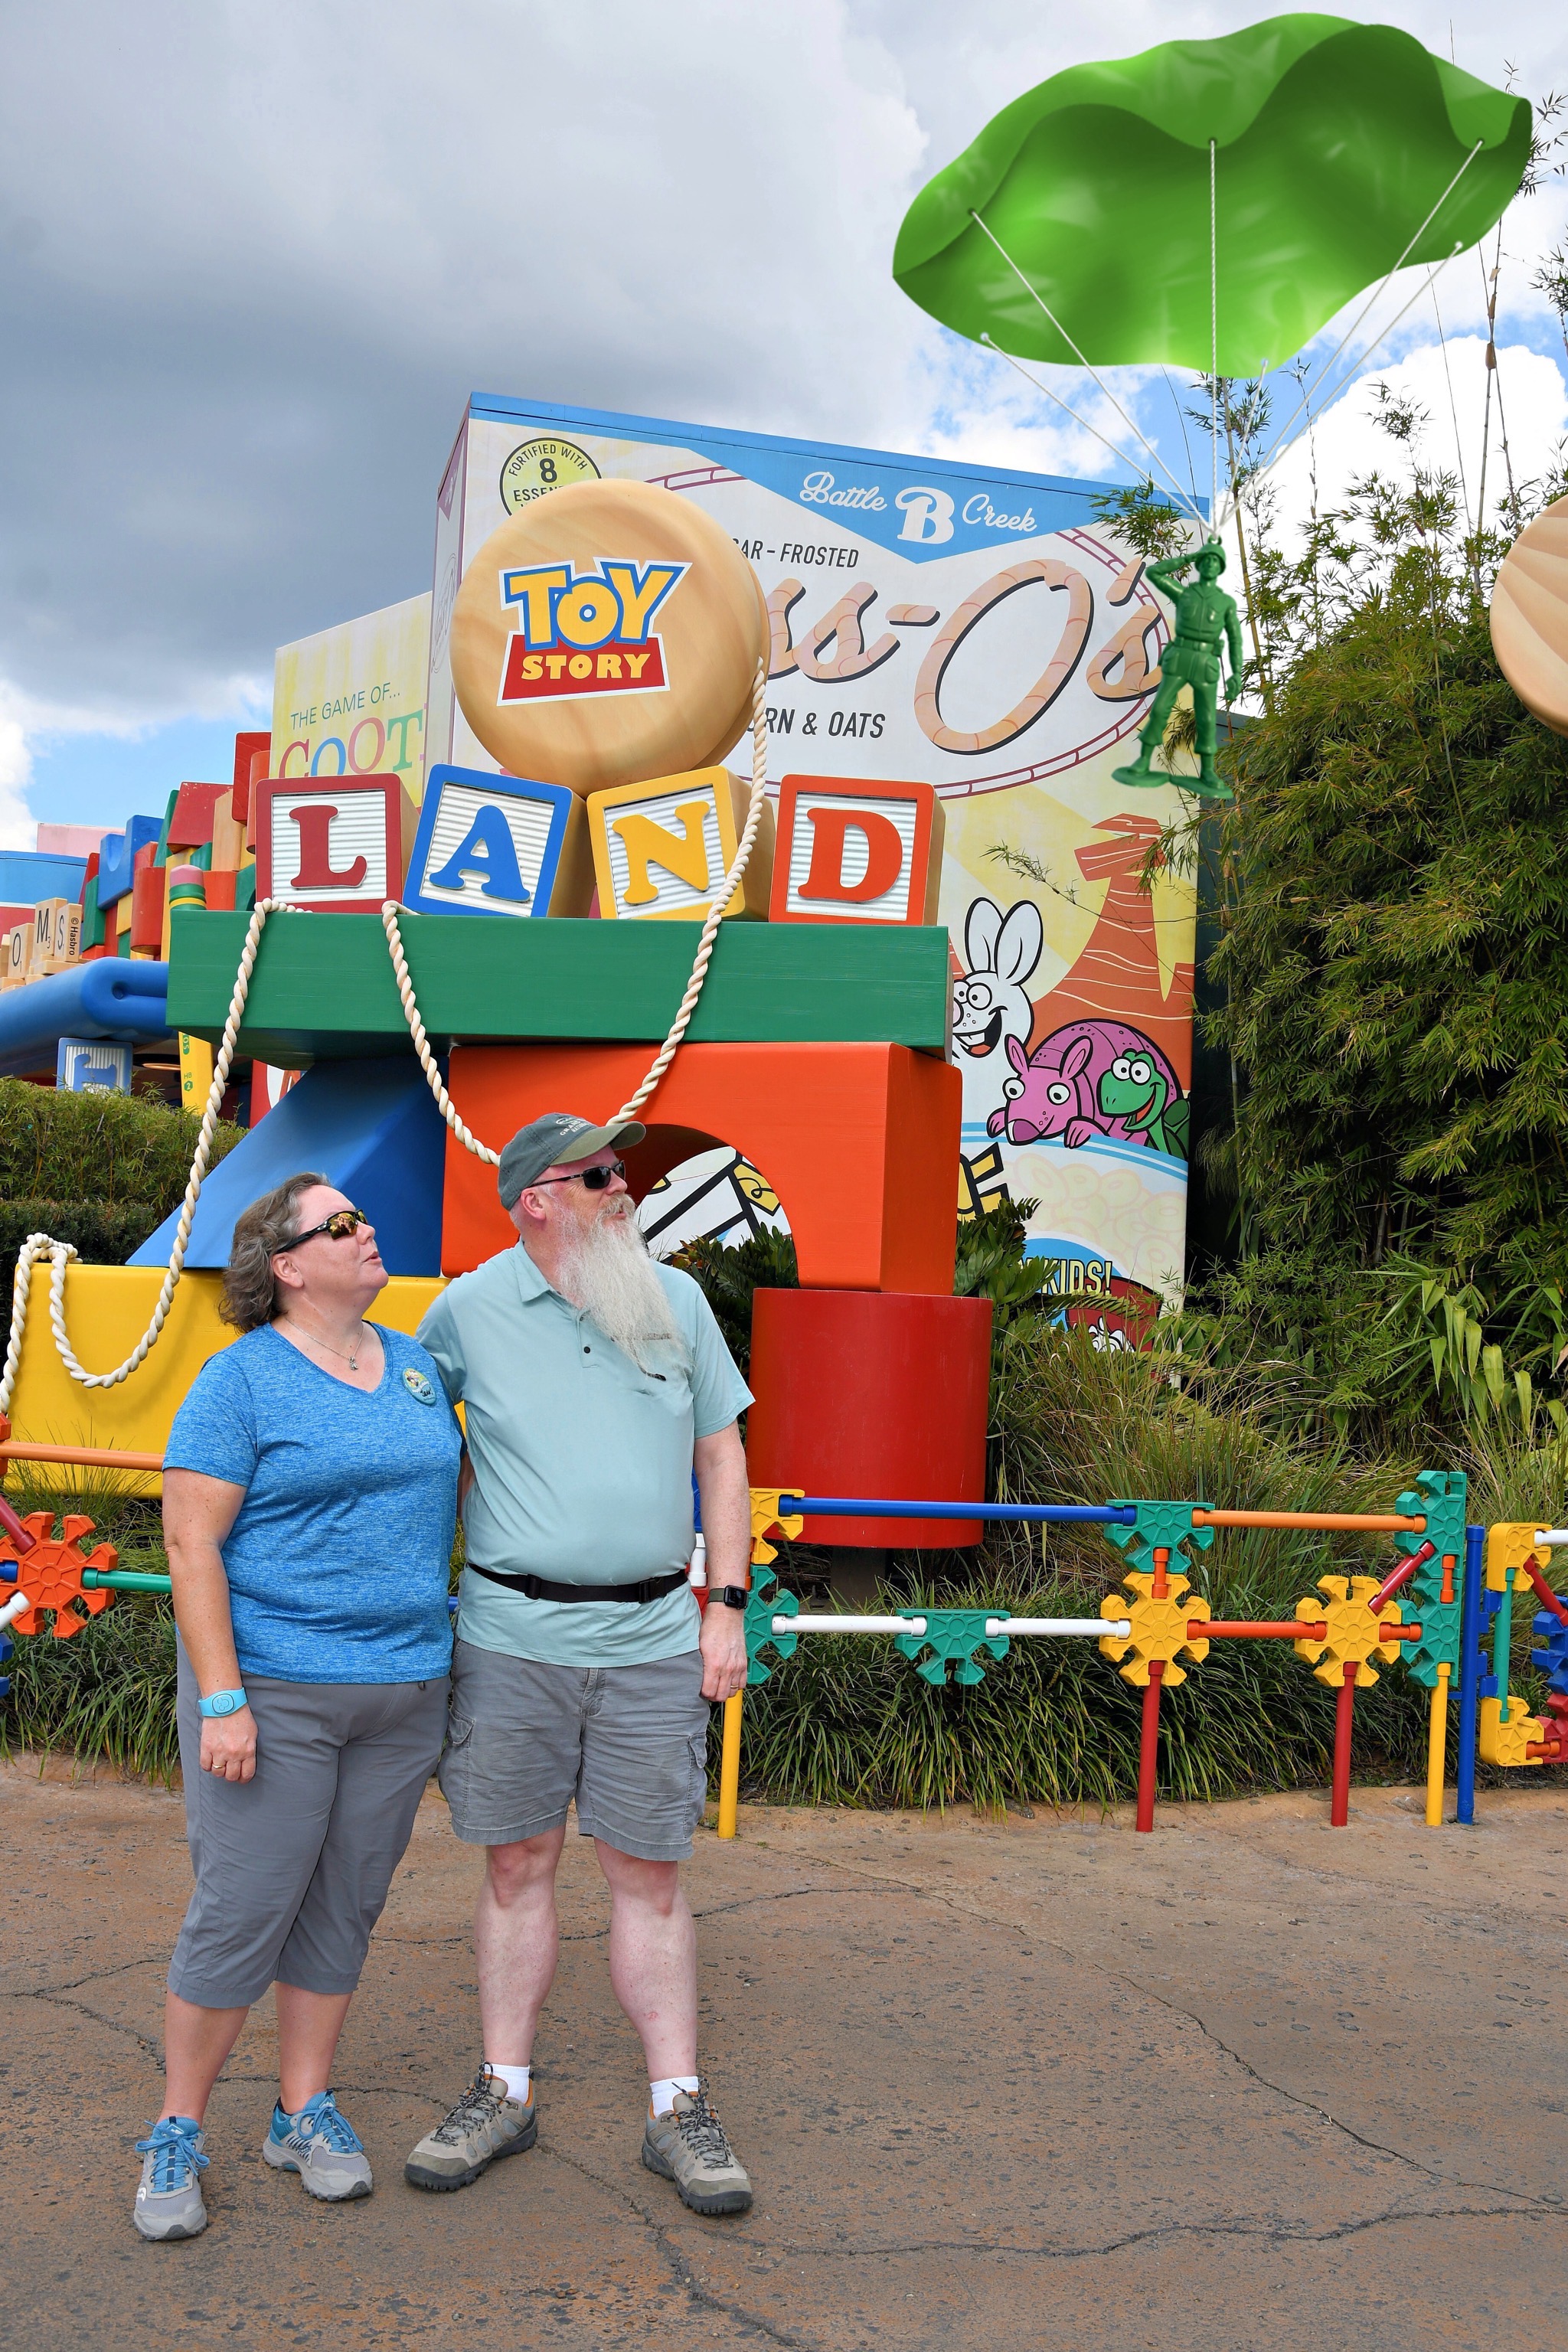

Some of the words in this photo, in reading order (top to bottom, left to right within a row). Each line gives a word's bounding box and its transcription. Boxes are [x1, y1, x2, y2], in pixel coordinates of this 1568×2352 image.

[508, 444, 557, 476] FORTIFIED
[560, 446, 588, 470] WITH
[539, 458, 557, 483] 8
[799, 471, 888, 511] Battle
[895, 486, 956, 544] B
[962, 494, 1037, 532] Creek
[504, 561, 685, 652] TOY
[521, 653, 651, 680] STORY
[290, 707, 317, 730] THE
[322, 691, 365, 720] GAME
[746, 707, 795, 734] RN
[802, 712, 818, 735] &
[828, 711, 886, 738] OATS
[279, 709, 428, 779] COOT
[69, 926, 79, 956] Hasbro
